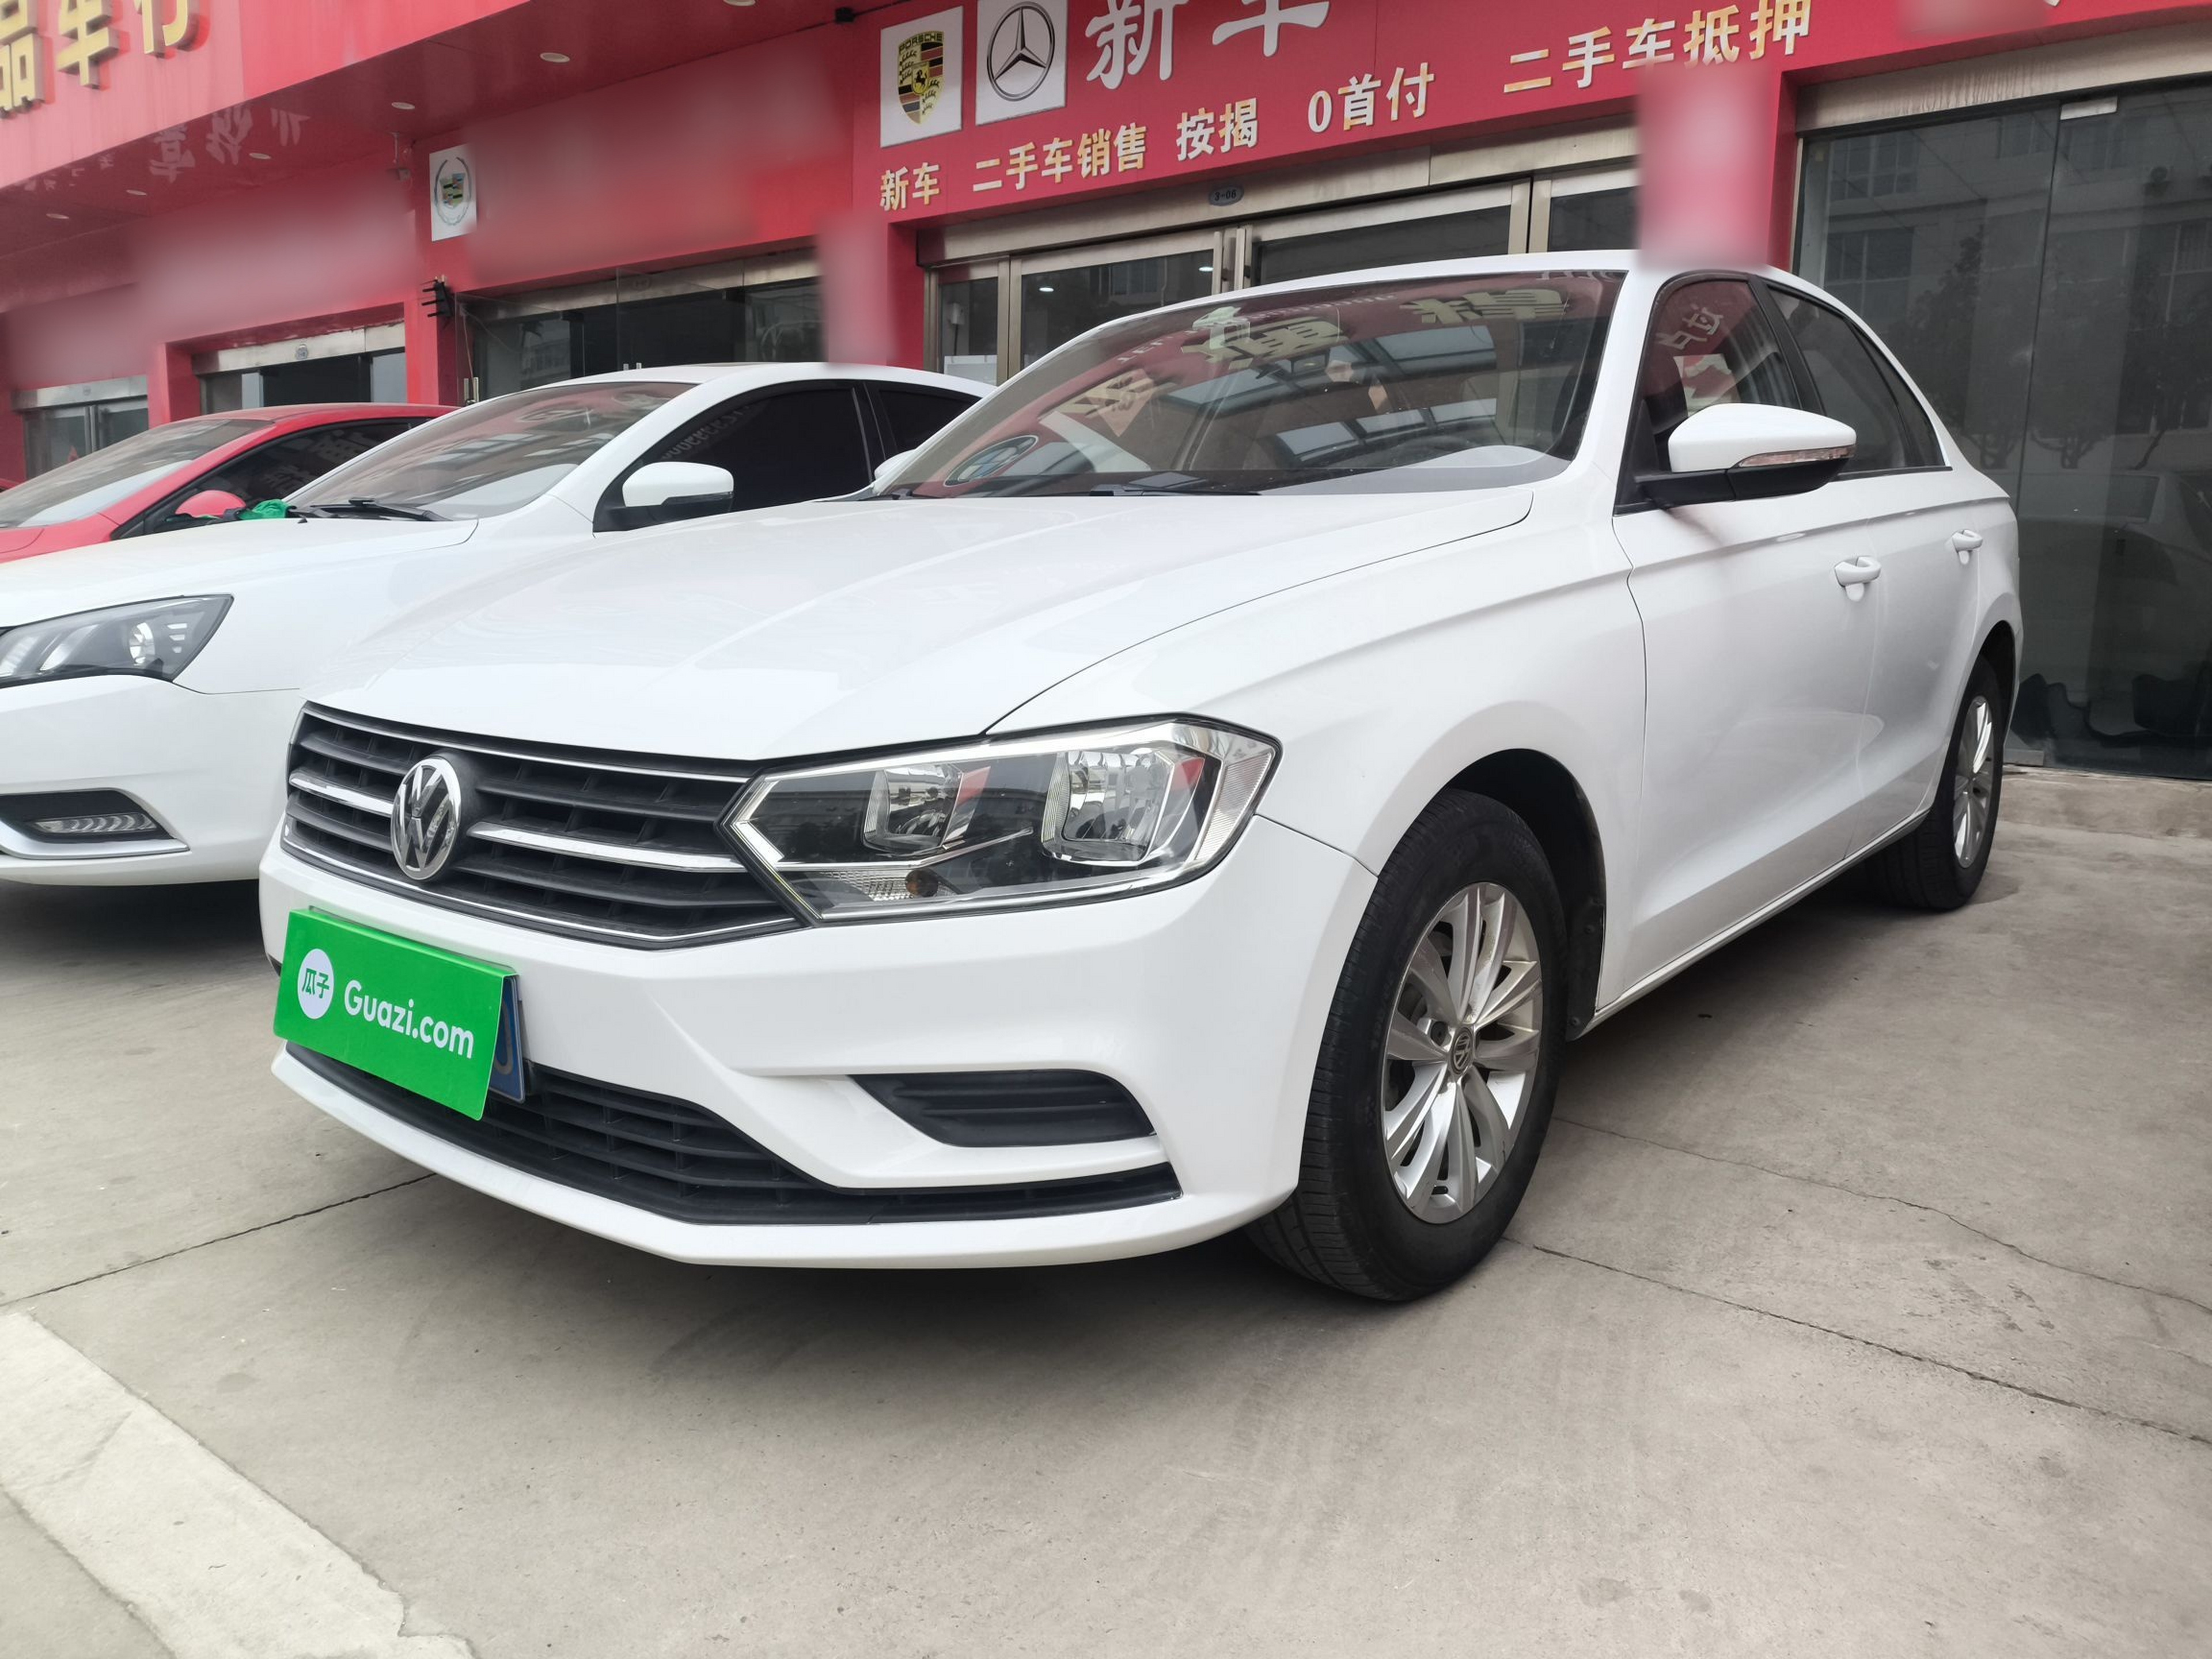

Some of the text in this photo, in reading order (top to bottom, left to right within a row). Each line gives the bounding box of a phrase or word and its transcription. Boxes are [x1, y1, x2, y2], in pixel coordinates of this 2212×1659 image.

[880, 0, 1811, 211] 新车 二手车销售 按揭 0首付 二手车抵押
[301, 967, 330, 999] 瓜子
[344, 979, 475, 1059] Guazi.com
